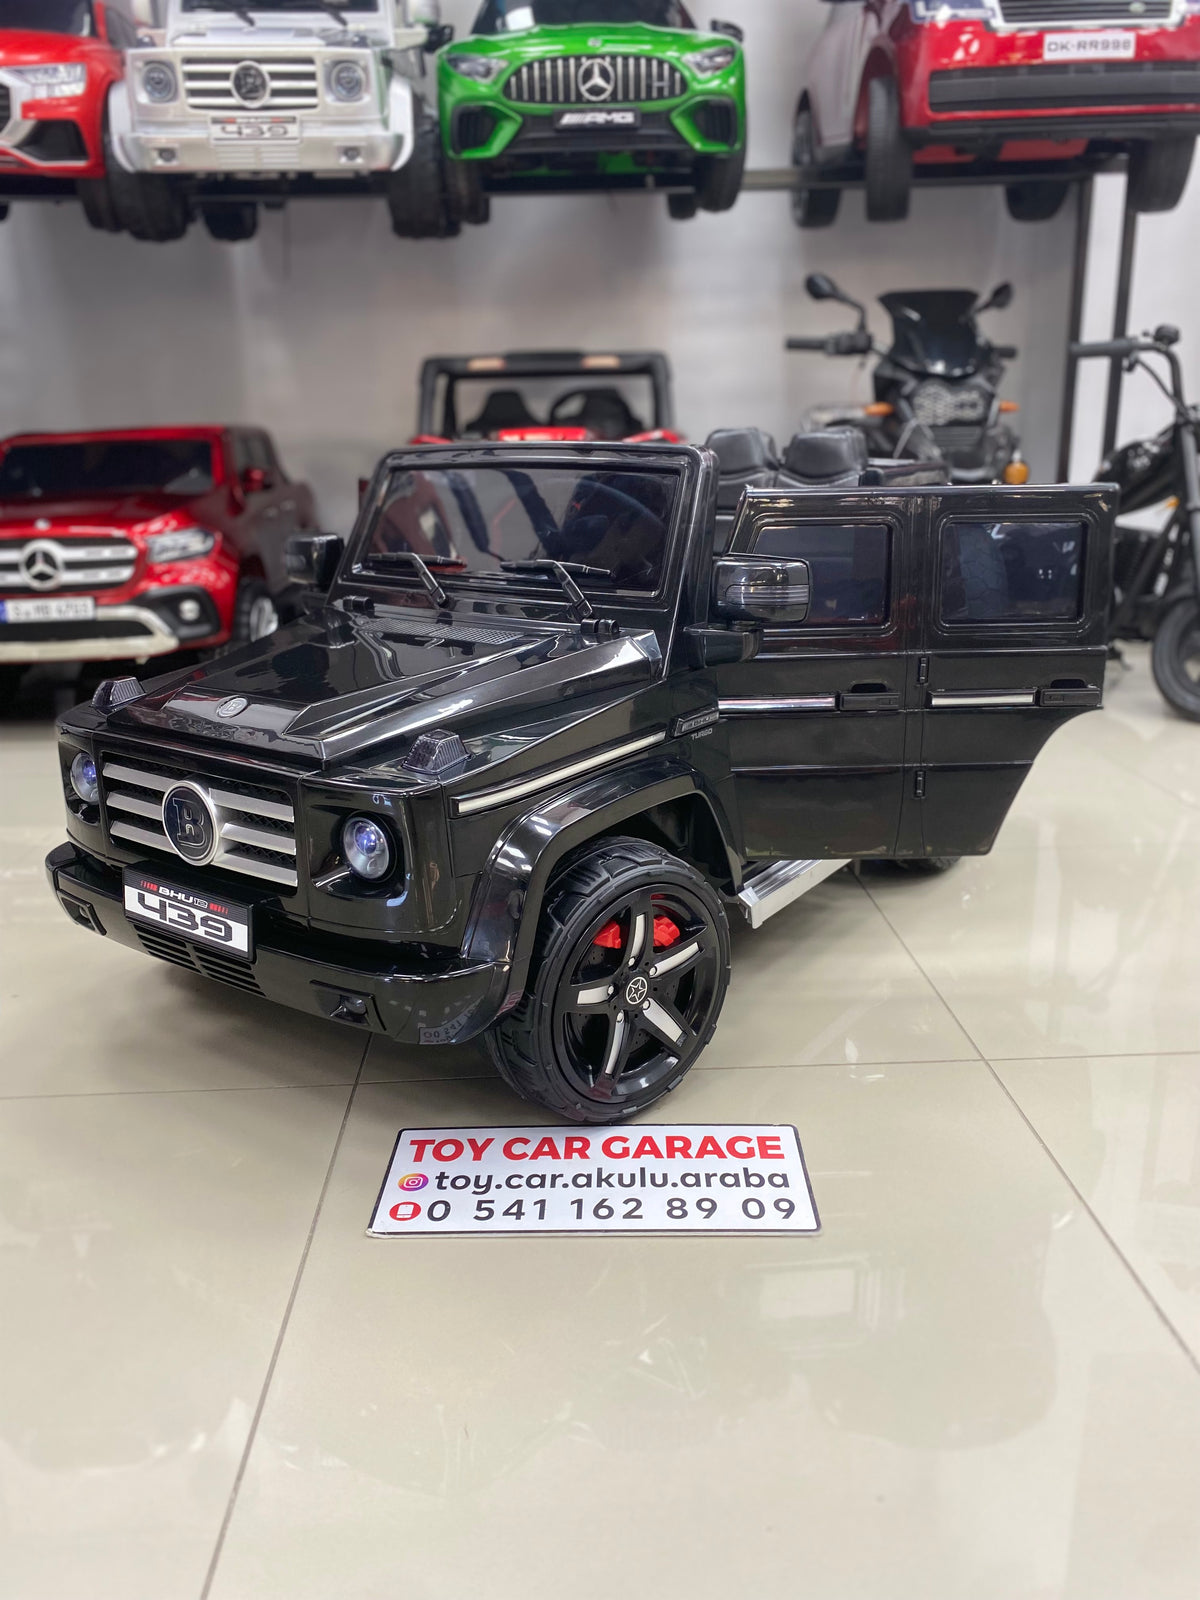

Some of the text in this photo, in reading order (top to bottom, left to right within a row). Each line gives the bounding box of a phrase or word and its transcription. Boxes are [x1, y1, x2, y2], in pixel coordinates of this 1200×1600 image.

[137, 891, 233, 943] 439
[409, 1135, 785, 1163] TOY CAR GARAGE
[434, 1166, 790, 1196] toy.car.akulu.araba
[427, 1197, 796, 1222] 0 541 162 89 09
